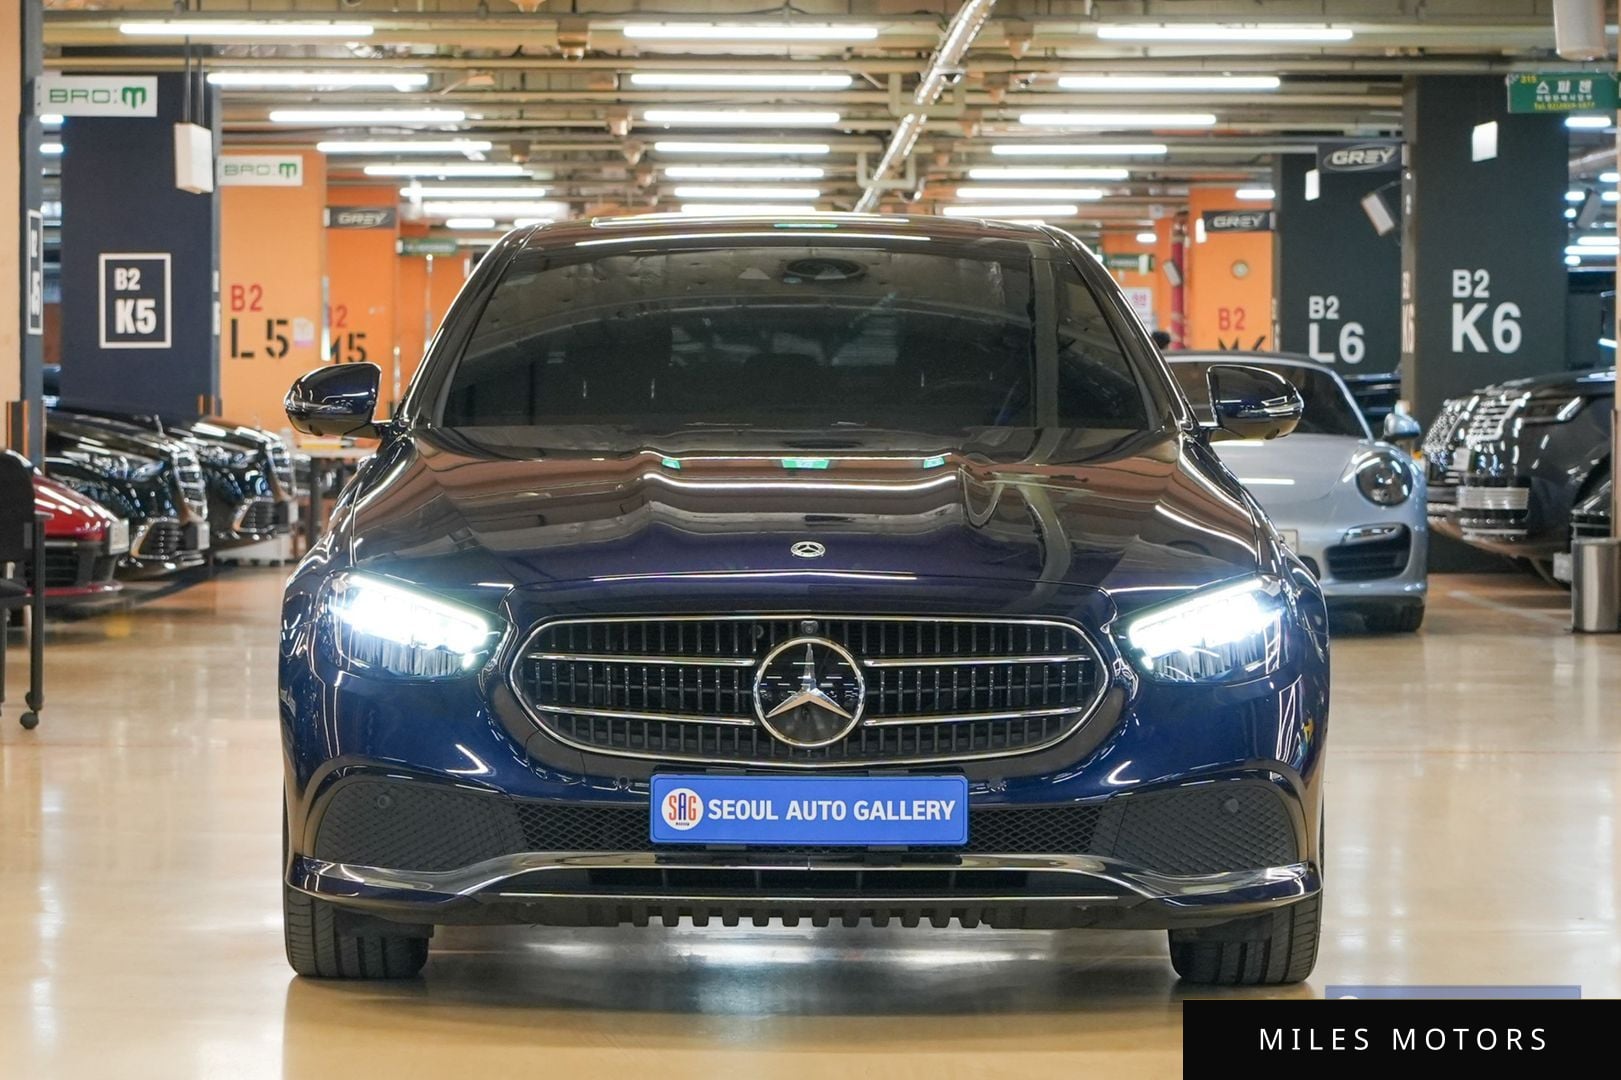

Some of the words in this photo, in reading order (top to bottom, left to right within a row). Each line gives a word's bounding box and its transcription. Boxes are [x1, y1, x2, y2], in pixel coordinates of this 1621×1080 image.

[1332, 146, 1396, 165] GREY
[337, 212, 388, 225] GREY
[1213, 213, 1265, 228] GREY
[114, 267, 141, 291] B2
[1452, 269, 1490, 298] B2
[231, 284, 263, 312] B2
[1309, 295, 1340, 320] B2
[115, 298, 157, 335] K5
[1218, 307, 1245, 331] B2
[1452, 302, 1522, 353] K6
[1308, 321, 1366, 364] L6
[669, 792, 697, 821] SAG
[708, 798, 779, 821] SEOUL
[785, 798, 847, 821] AUTO
[853, 798, 957, 821] GALLERY
